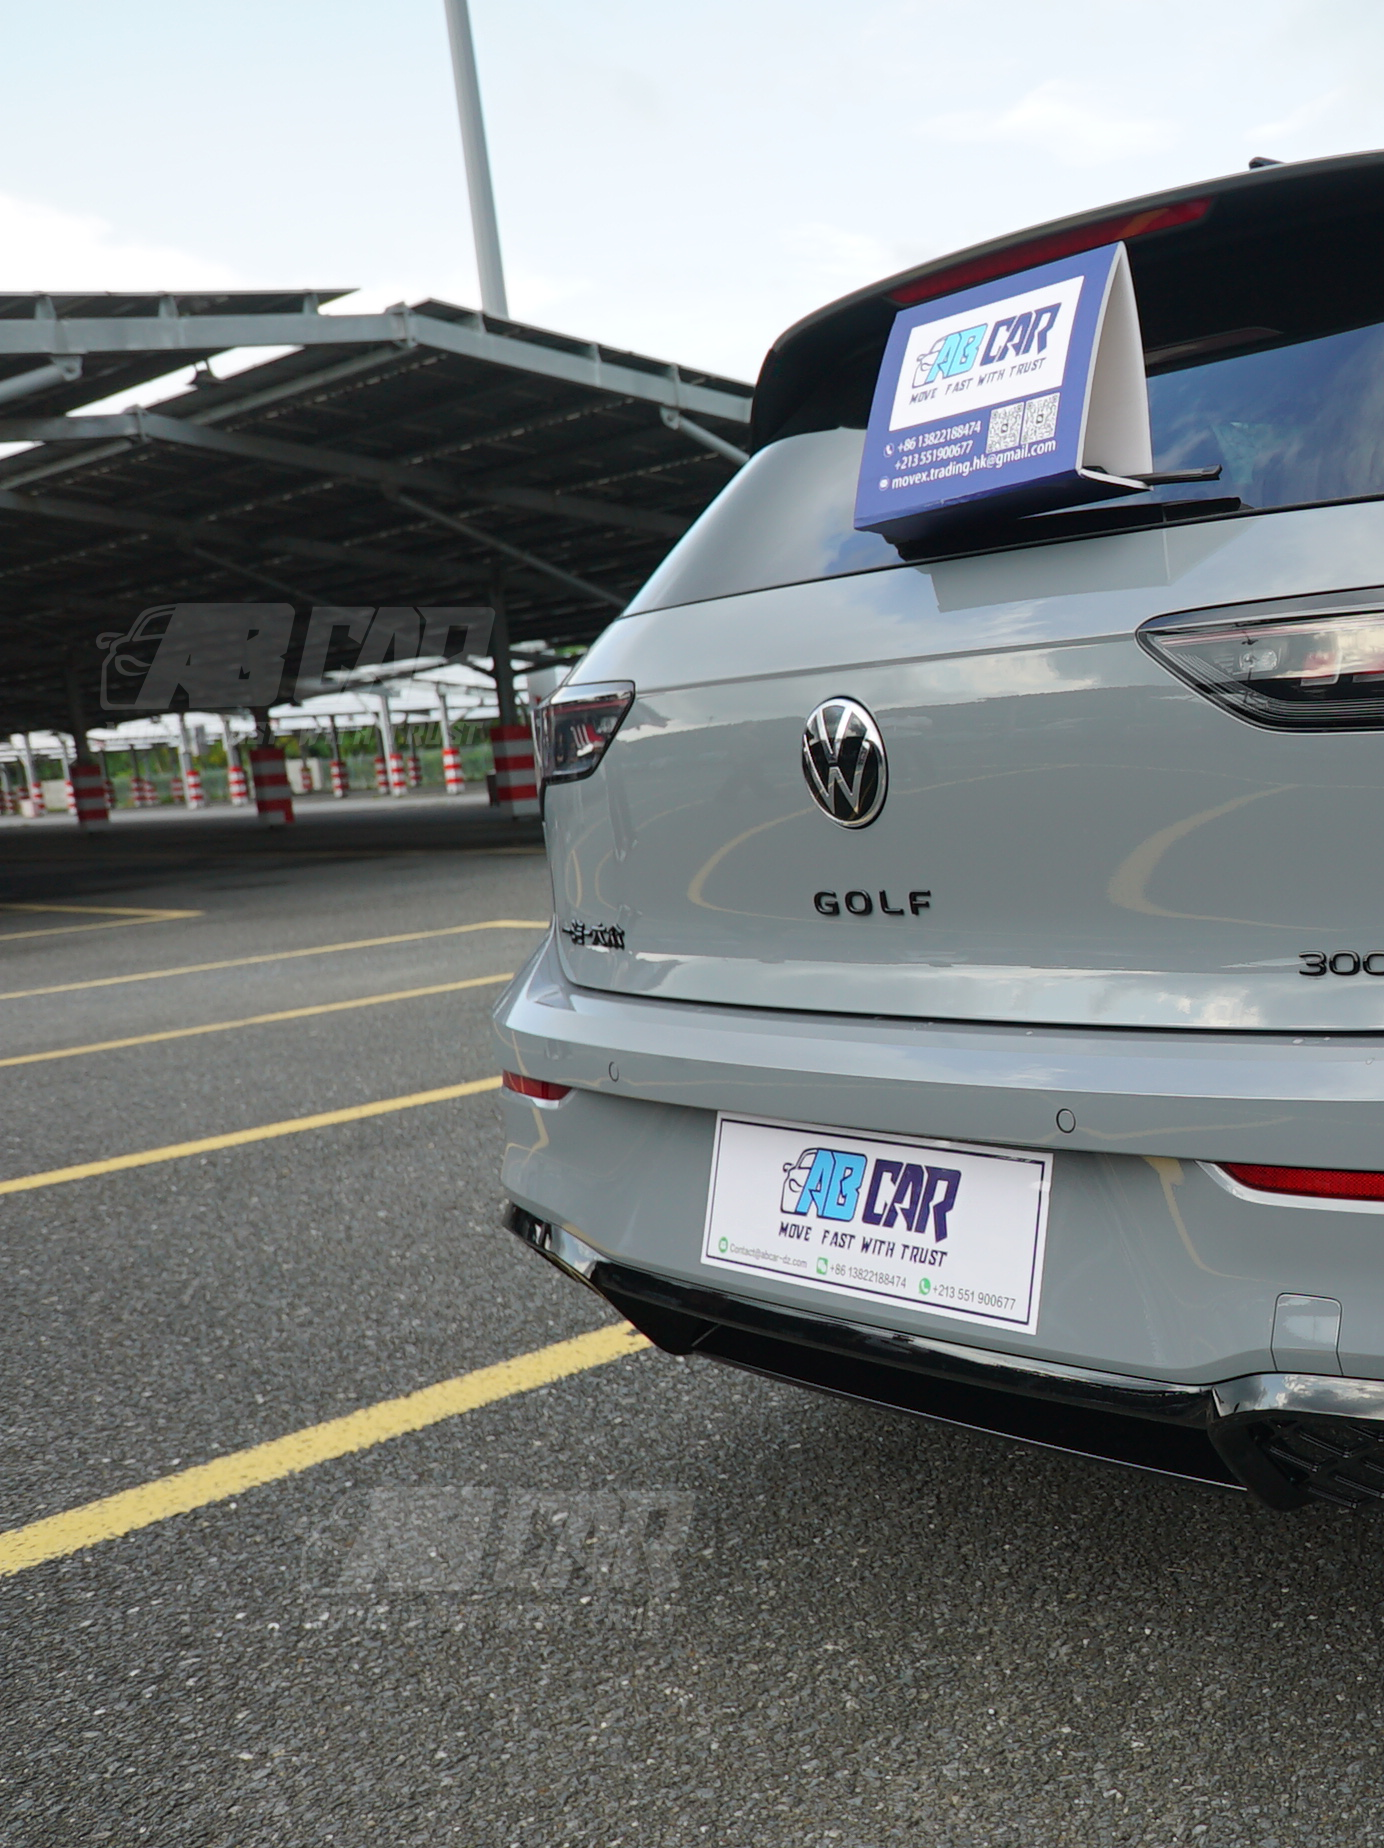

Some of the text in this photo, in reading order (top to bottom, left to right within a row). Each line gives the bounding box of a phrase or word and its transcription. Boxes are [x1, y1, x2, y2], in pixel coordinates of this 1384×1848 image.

[980, 302, 1062, 366] CAR
[909, 357, 1047, 405] MOVE FAST WITH TRUST
[894, 441, 973, 471] +213 551900677
[897, 421, 982, 454] +86 13822188474
[892, 440, 1056, 488] movex.trading.hk@gmail.com
[813, 889, 932, 916] GOLF
[796, 1148, 962, 1243] AB CAR
[779, 1221, 948, 1267] MOVE FAST WITH TRUST
[829, 1263, 846, 1277] +86
[848, 1267, 907, 1290] 13822188474
[932, 1283, 955, 1298] +213
[958, 1287, 975, 1303] 551
[978, 1291, 1016, 1311] 900677
